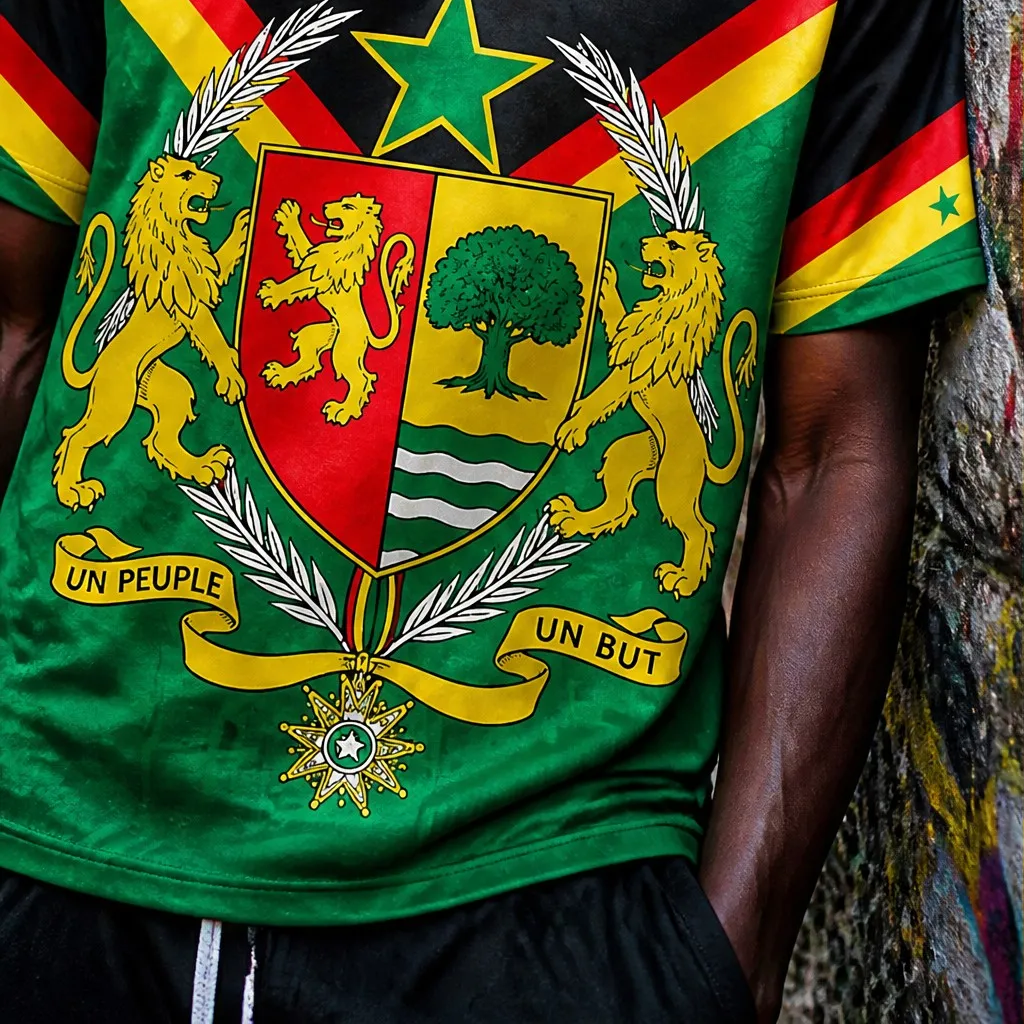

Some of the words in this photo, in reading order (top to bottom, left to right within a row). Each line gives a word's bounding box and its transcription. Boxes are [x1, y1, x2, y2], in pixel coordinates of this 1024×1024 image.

[66, 566, 107, 594] UN
[118, 565, 224, 600] PEUPLE
[536, 616, 584, 649] UN
[595, 632, 661, 675] BUT
